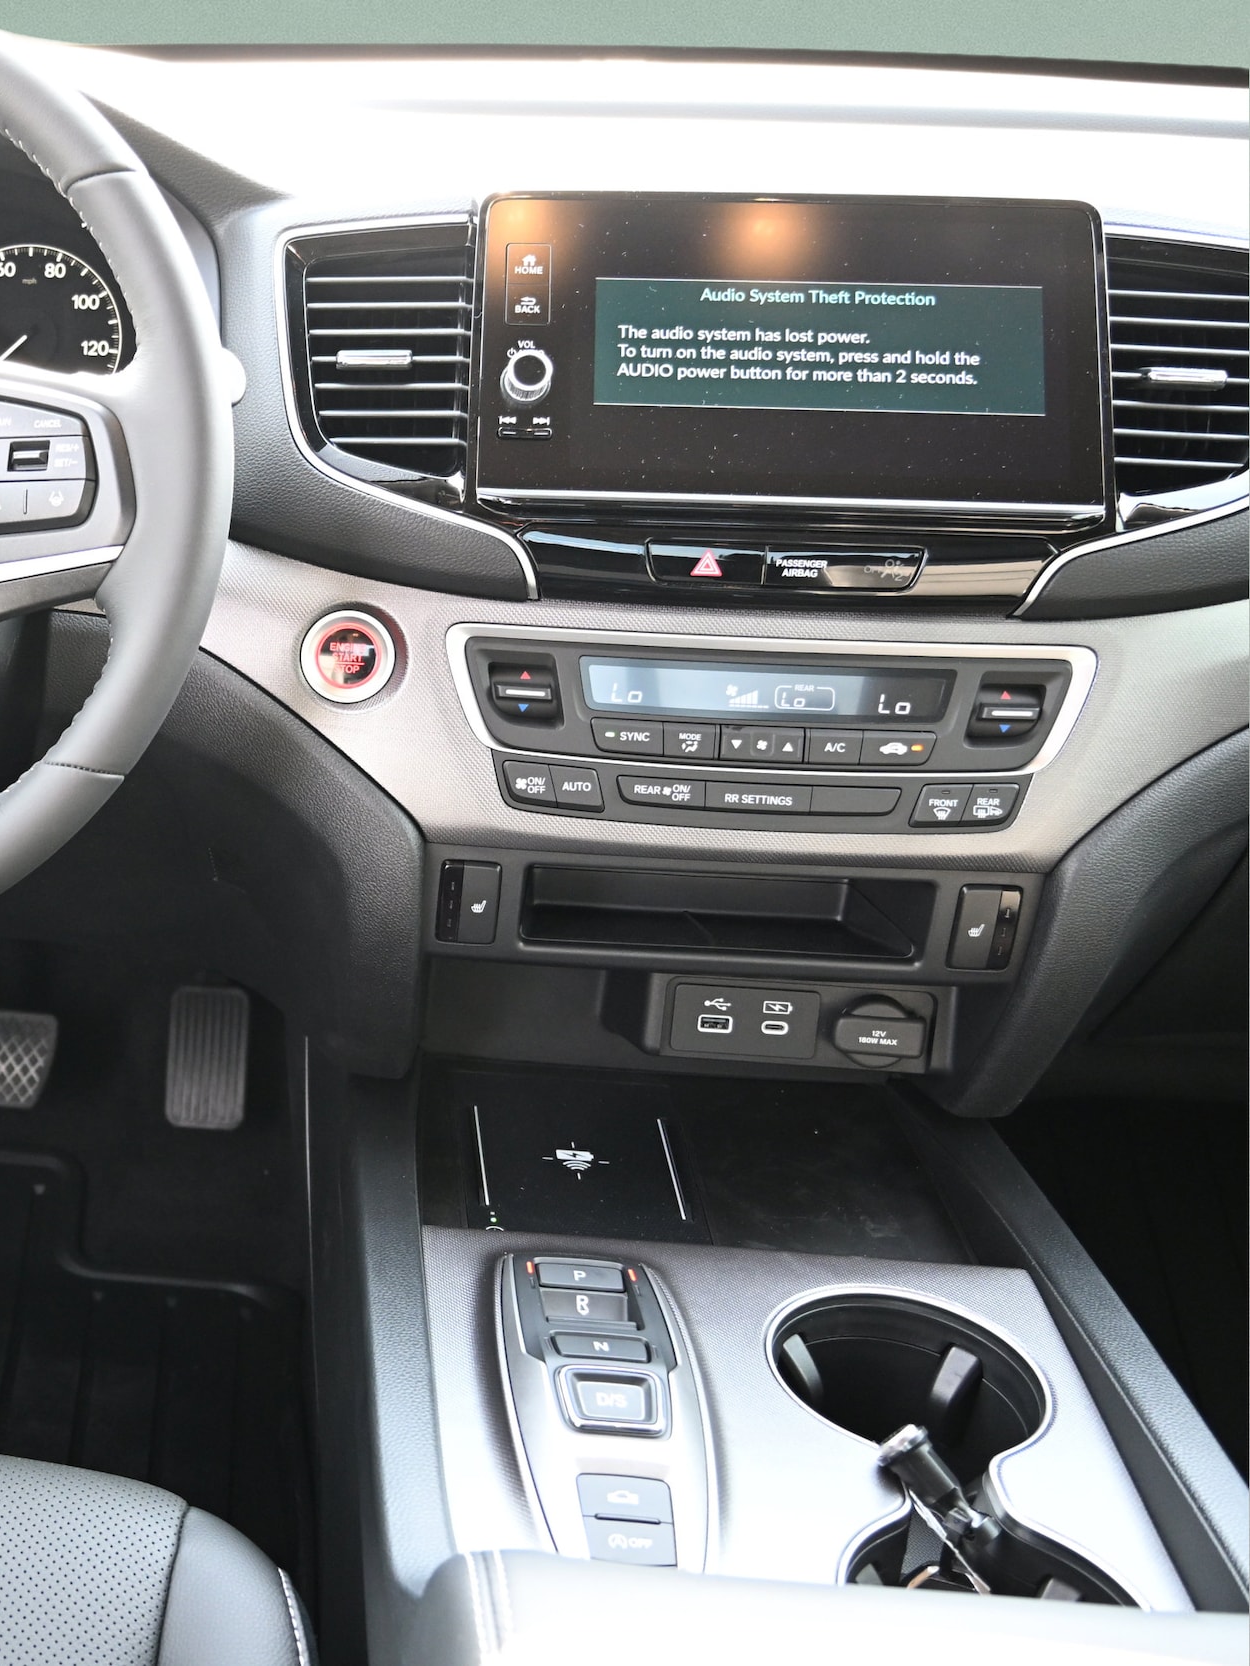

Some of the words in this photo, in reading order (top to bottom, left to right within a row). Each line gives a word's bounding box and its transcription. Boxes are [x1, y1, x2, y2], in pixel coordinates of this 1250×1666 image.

[44, 262, 66, 279] 80
[515, 266, 543, 275] HOME
[700, 287, 745, 302] Audio
[749, 288, 804, 305] System
[808, 289, 850, 304] Theft
[855, 290, 936, 306] Protection
[71, 294, 100, 310] 100
[515, 305, 540, 314] BACK
[617, 324, 647, 340] The
[651, 326, 694, 341] audio
[697, 328, 751, 343] system
[755, 328, 781, 342] has
[785, 328, 813, 343] lost
[817, 331, 870, 345] power.
[81, 339, 109, 356] 120
[517, 340, 536, 349] VOL
[617, 343, 636, 358] To
[640, 345, 672, 359] turn
[676, 347, 696, 359] on
[700, 346, 726, 360] the
[729, 346, 772, 361] audio
[776, 348, 835, 364] system,
[838, 351, 878, 366] press
[882, 350, 911, 365] and
[915, 350, 950, 366] hold
[954, 351, 981, 366] the
[617, 363, 673, 378] AUDIO
[677, 366, 726, 381] power
[730, 364, 782, 380] button
[785, 366, 809, 381] for
[812, 369, 853, 382] more
[856, 368, 892, 383] than
[895, 369, 907, 383] 2
[910, 370, 978, 385] seconds.
[34, 419, 62, 429] CANCEL
[775, 559, 828, 569] PASSENGER
[782, 569, 818, 578] AIRBAG
[330, 642, 366, 652] ENGINE
[332, 652, 362, 662] START
[334, 664, 360, 674] STOP
[610, 682, 642, 704] Lo
[795, 684, 814, 693] REAR
[781, 691, 805, 708] Lo
[878, 694, 911, 715] Lo
[619, 731, 650, 742] SYNC
[679, 733, 701, 741] MODE
[824, 742, 846, 753] A/C
[527, 777, 546, 786] ON/
[562, 782, 591, 791] AUTO
[527, 785, 546, 794] OFF
[634, 784, 661, 795] REAR
[672, 784, 691, 793] ON/
[671, 793, 691, 802] OFF
[724, 793, 739, 803] RR
[741, 794, 793, 806] SETTINGS
[928, 798, 958, 807] FRONT
[977, 798, 1000, 806] REAR
[879, 1038, 897, 1046] MAX
[573, 1270, 587, 1281] P
[576, 1295, 589, 1312] R
[593, 1341, 610, 1352] N
[596, 1391, 627, 1408] D/S
[628, 1537, 654, 1549] OFF
